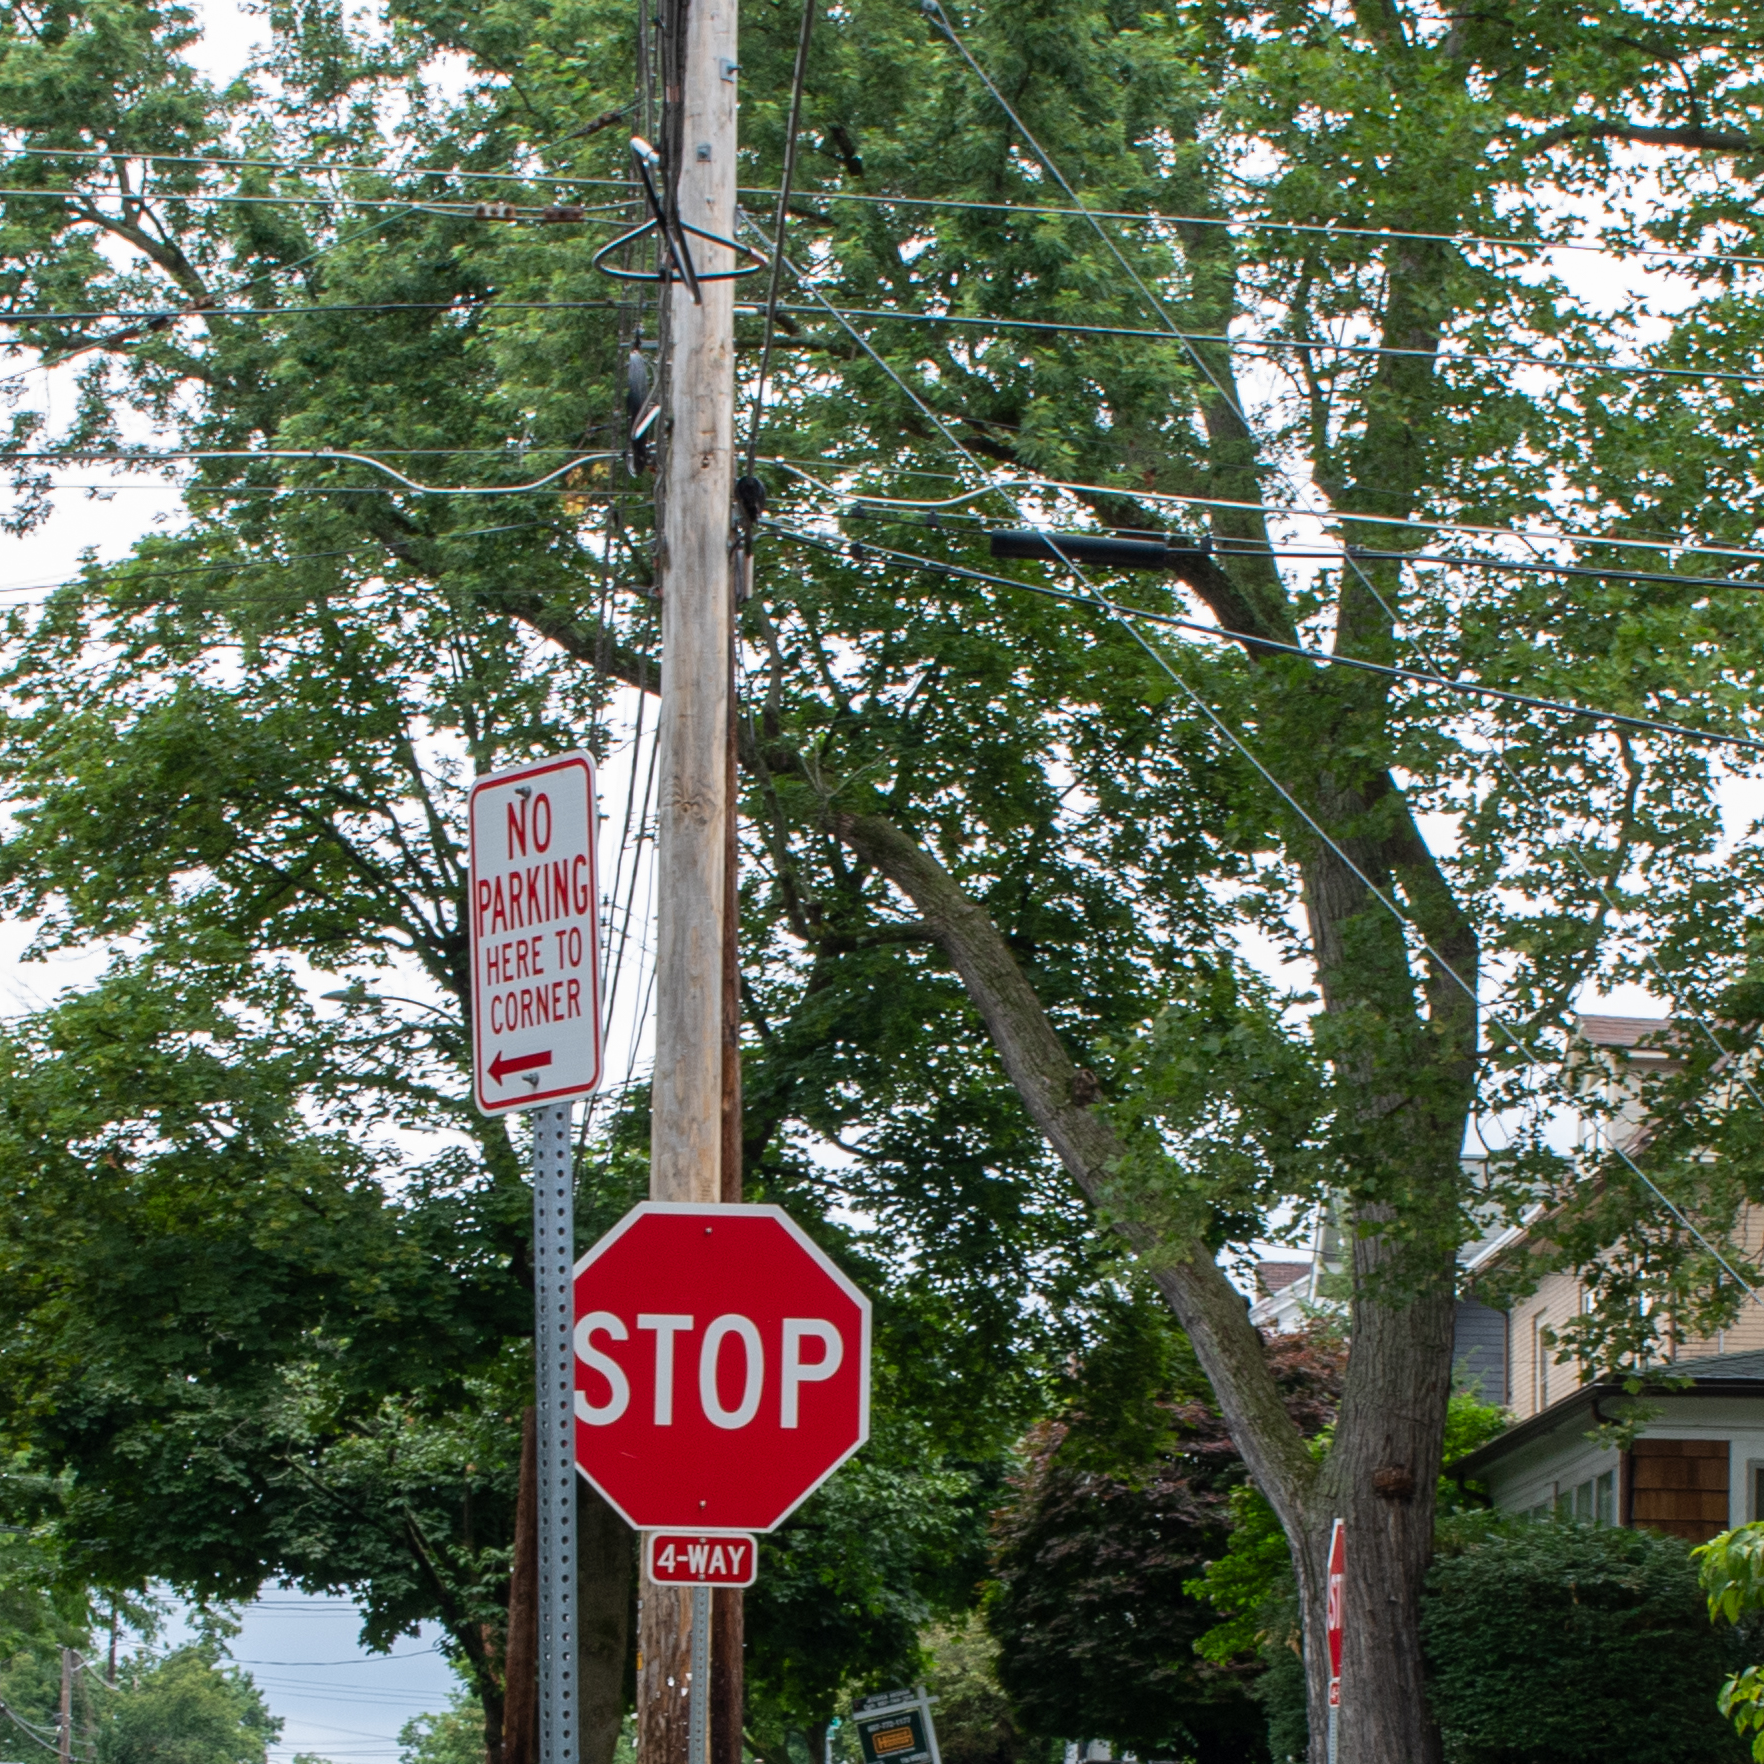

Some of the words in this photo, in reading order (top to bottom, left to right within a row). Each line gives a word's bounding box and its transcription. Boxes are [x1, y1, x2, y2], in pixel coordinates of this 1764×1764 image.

[507, 793, 552, 859] NO
[478, 854, 588, 937] PARKING
[487, 936, 543, 986] HERE
[555, 927, 582, 971] TO
[491, 978, 581, 1034] CORNER
[573, 1311, 843, 1430] STOP
[657, 1544, 746, 1575] 4-WAY
